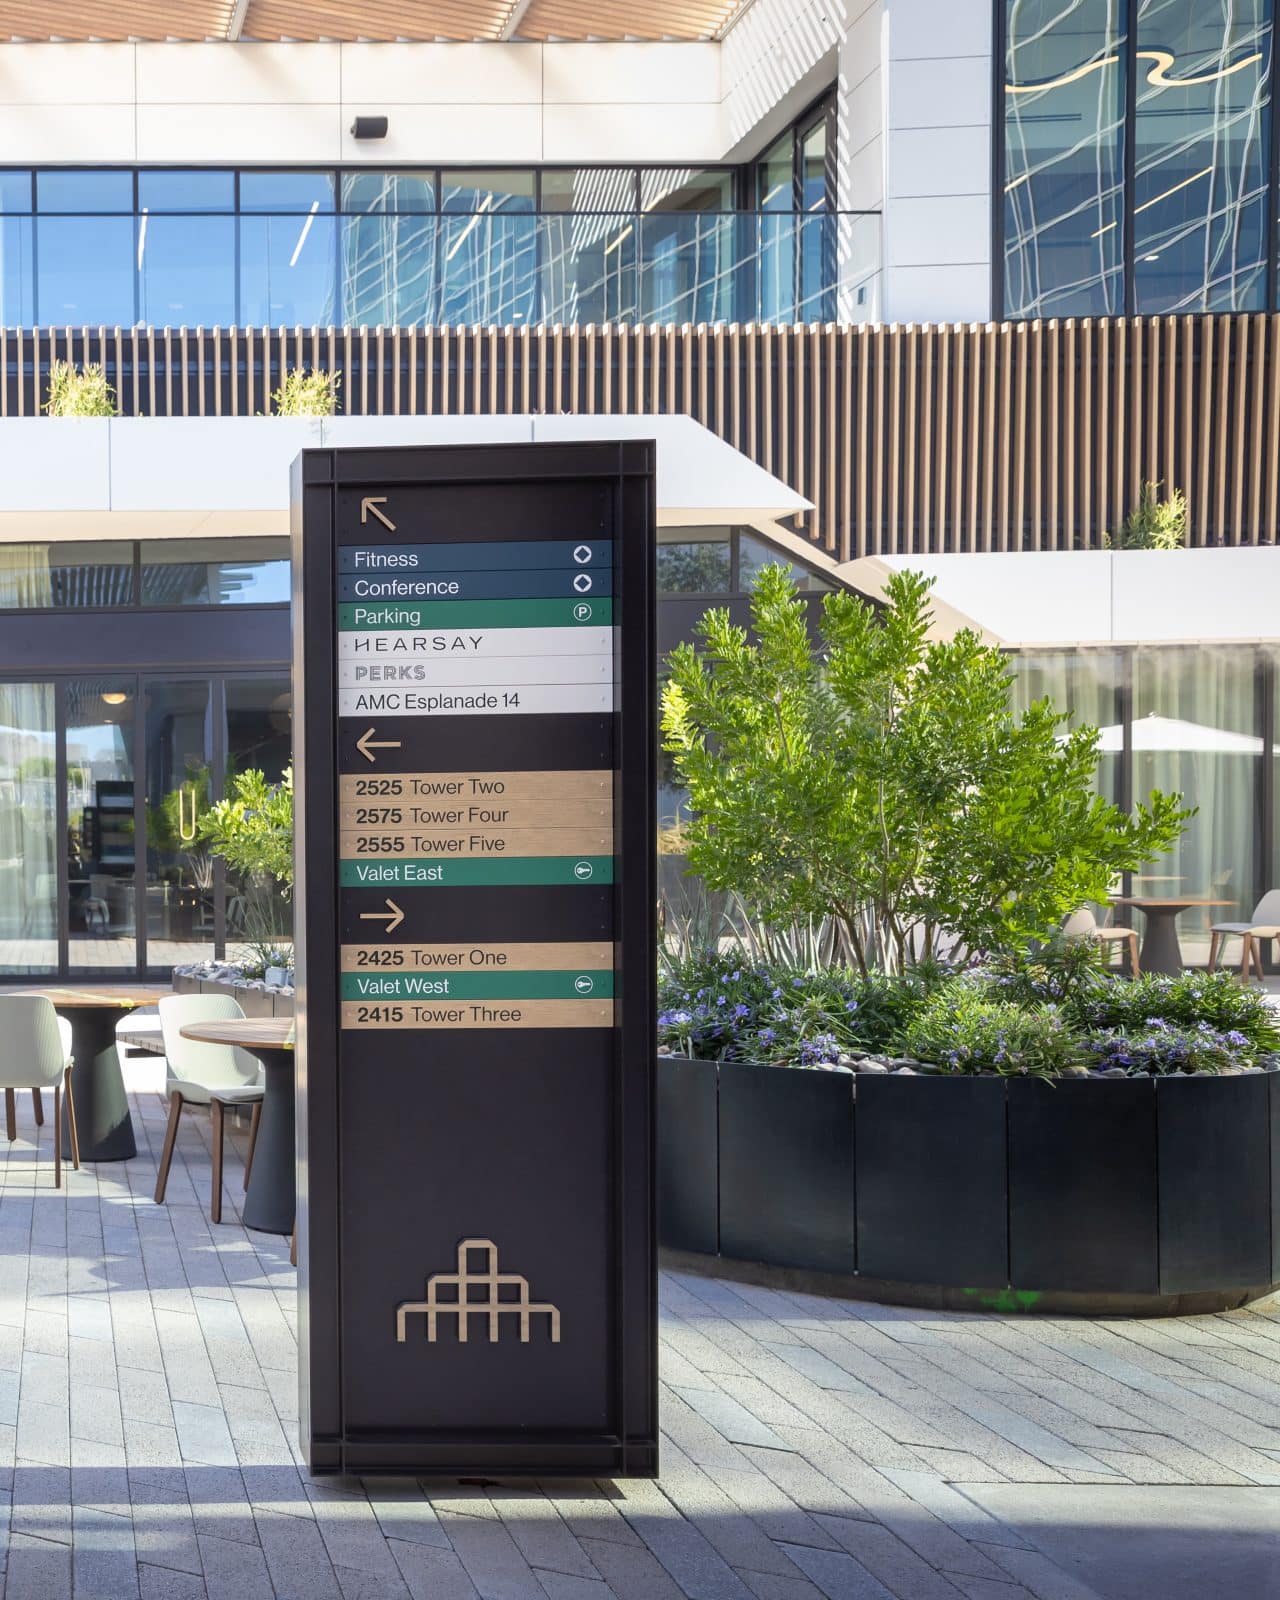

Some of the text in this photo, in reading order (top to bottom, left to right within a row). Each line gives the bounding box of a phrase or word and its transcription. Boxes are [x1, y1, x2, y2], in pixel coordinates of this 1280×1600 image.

[355, 551, 419, 568] Fitness
[354, 579, 460, 597] Conference
[355, 607, 421, 627] Parking
[354, 636, 484, 652] HEARSAY
[355, 664, 426, 681] PERKS
[355, 692, 521, 713] AMC Esplanade 14
[355, 778, 506, 796] 2525 Tower Two
[356, 807, 510, 824] 2575 Tower Four
[356, 835, 506, 853] 2555 Tower Five
[356, 864, 444, 881] Valet East
[357, 949, 508, 966] 2425 Tower One
[357, 978, 450, 994] Valet West
[357, 1006, 522, 1023] 2415 Tower Three
